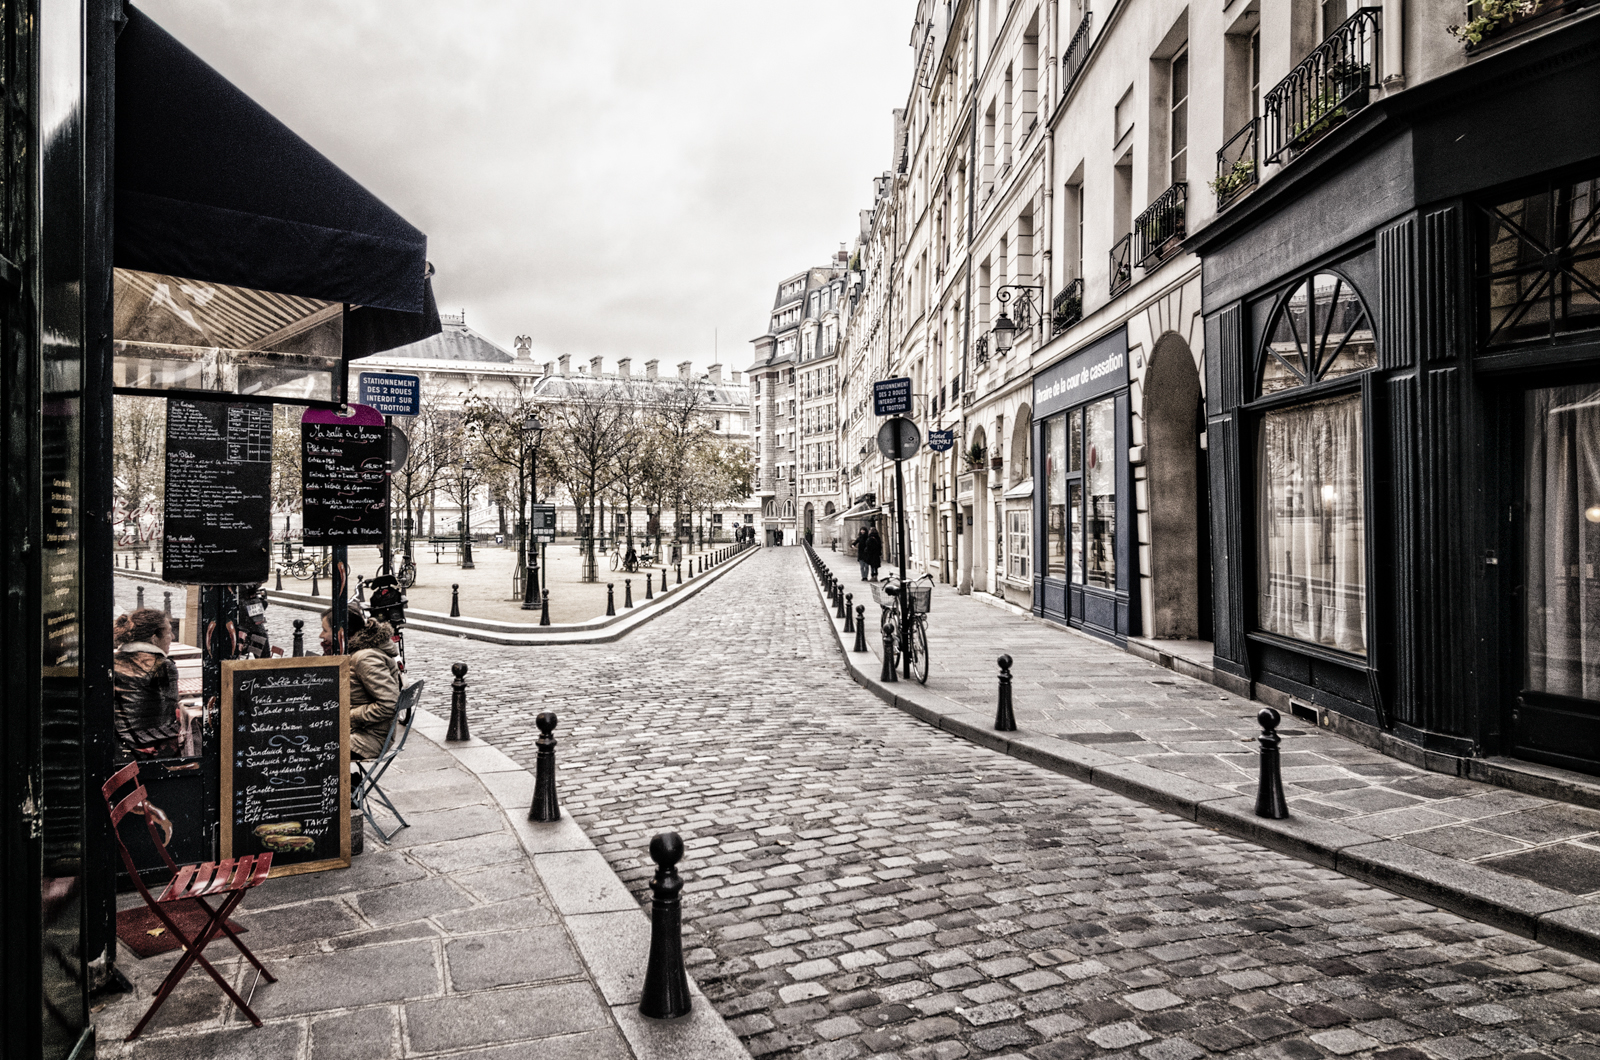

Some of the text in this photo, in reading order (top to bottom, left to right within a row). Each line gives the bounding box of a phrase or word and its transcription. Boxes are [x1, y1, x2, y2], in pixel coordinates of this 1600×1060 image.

[1053, 380, 1060, 396] de
[1060, 378, 1066, 393] la
[1067, 374, 1080, 390] cour
[1081, 366, 1089, 384] de
[1090, 352, 1123, 380] cassation
[363, 377, 416, 387] STATIONNEMENT
[876, 381, 908, 391] STATIONNEMENT
[380, 404, 410, 412] TROTTOIR
[293, 677, 299, 685] à
[251, 706, 282, 717] Salade
[250, 723, 274, 733] Salade
[245, 746, 282, 757] Sandwich
[300, 744, 321, 752] Choix
[246, 757, 280, 768] Sandwich
[246, 785, 275, 795] Canette
[245, 795, 261, 806] Eau
[244, 806, 262, 816] Café
[244, 814, 260, 824] Café
[304, 817, 332, 827] TAKE
